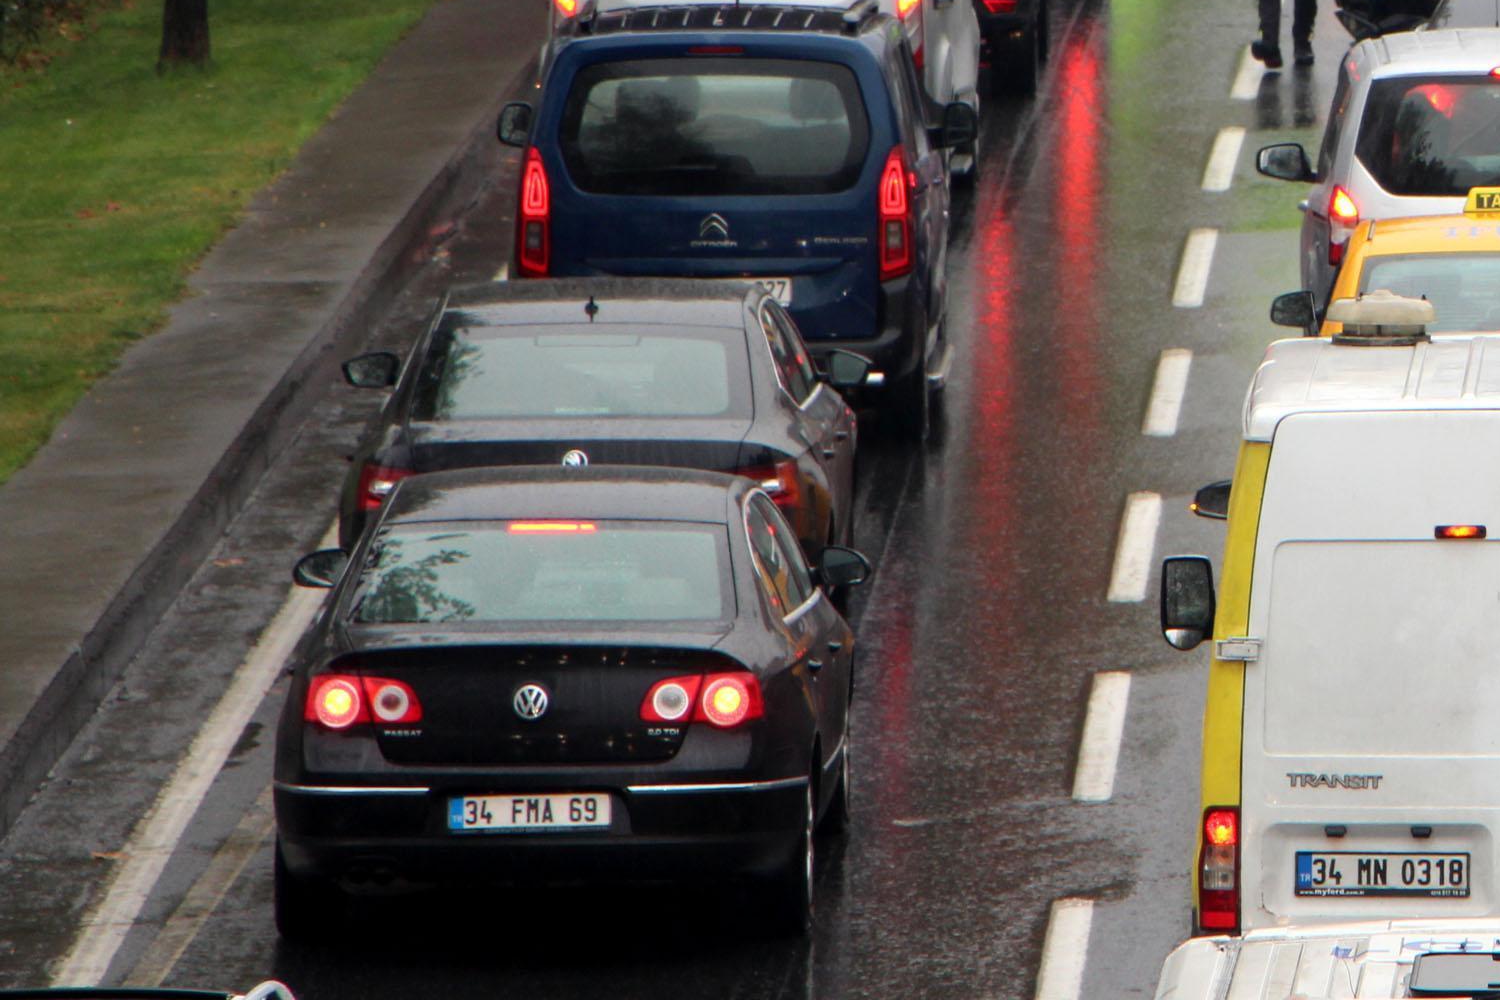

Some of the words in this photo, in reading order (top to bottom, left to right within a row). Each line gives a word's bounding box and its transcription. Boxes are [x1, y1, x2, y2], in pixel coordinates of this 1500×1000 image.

[664, 729, 680, 738] TDI
[1286, 773, 1383, 789] TRANSIT
[465, 802, 493, 825] 34
[511, 800, 554, 823] FMA
[569, 799, 598, 822] 69
[1300, 873, 1311, 883] TR
[1313, 859, 1342, 886] 34
[1357, 859, 1388, 886] MN
[1401, 859, 1463, 886] 0318
